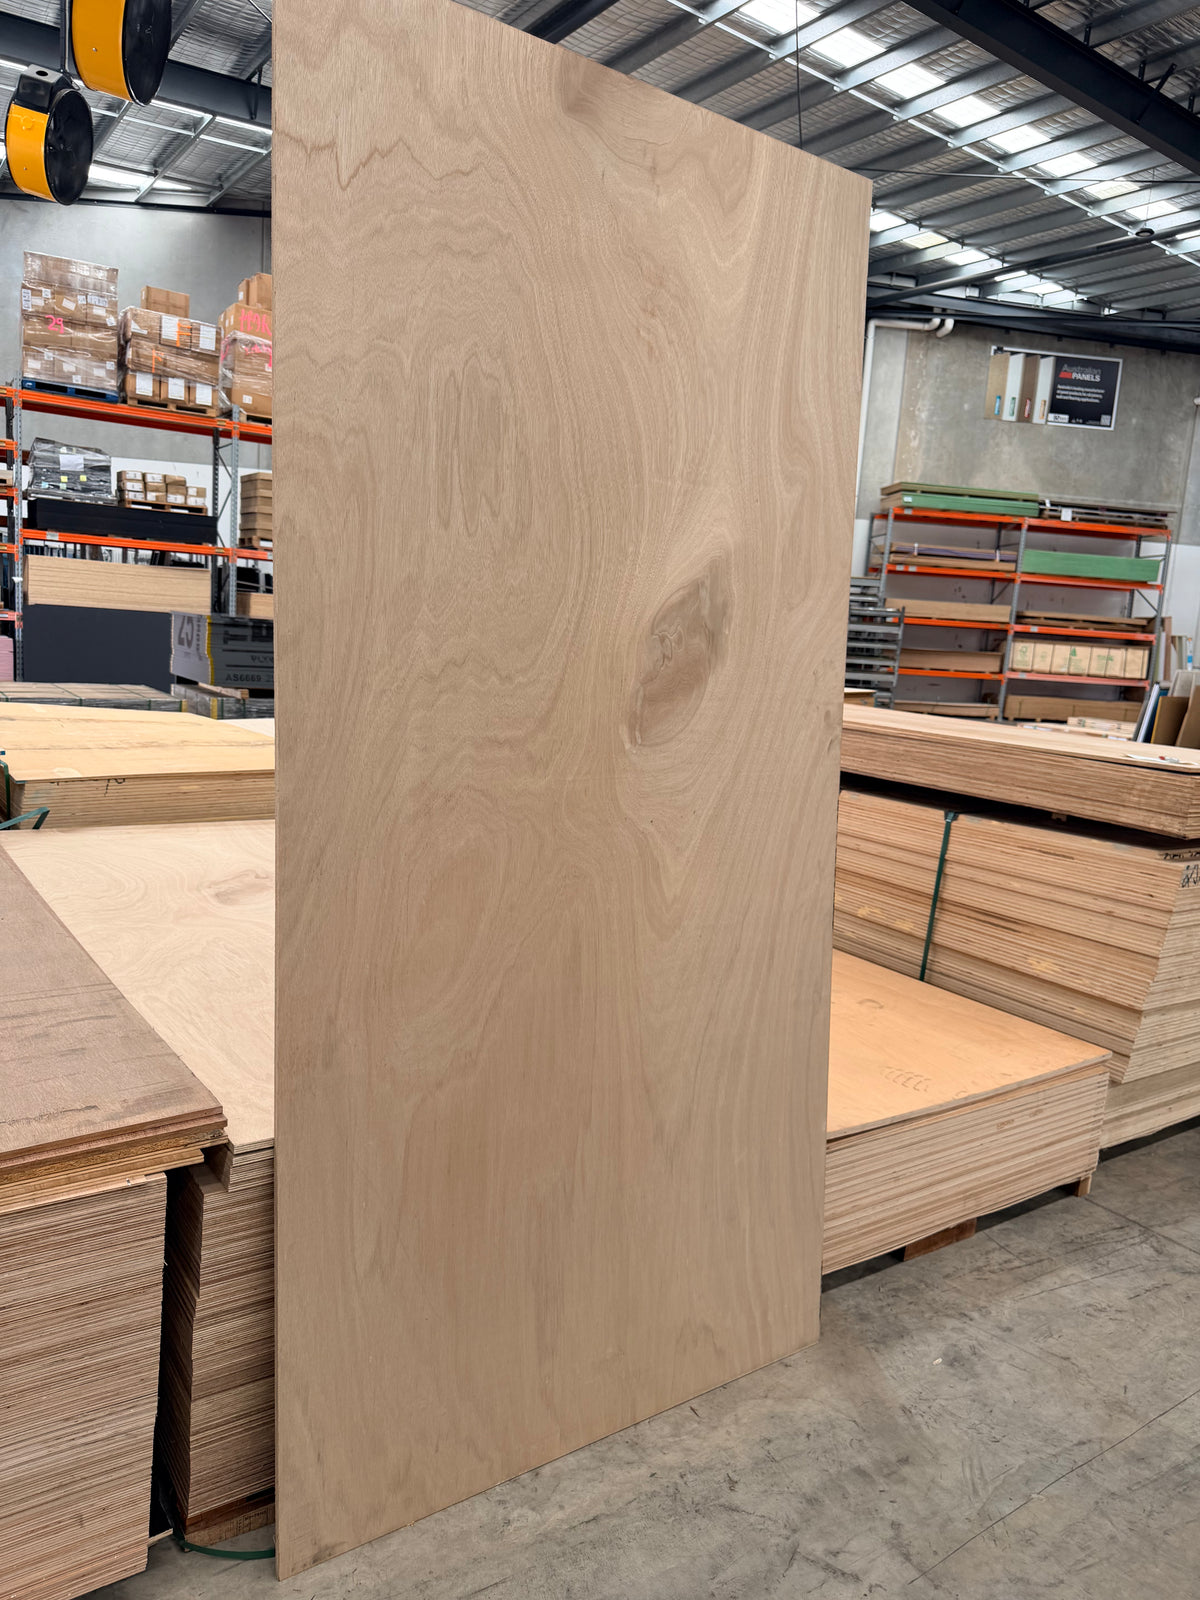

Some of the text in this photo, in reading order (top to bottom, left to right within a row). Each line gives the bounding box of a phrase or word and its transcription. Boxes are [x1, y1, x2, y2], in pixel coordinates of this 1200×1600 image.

[45, 315, 65, 334] 29
[1061, 364, 1102, 375] Australian
[1072, 372, 1101, 382] PANELS
